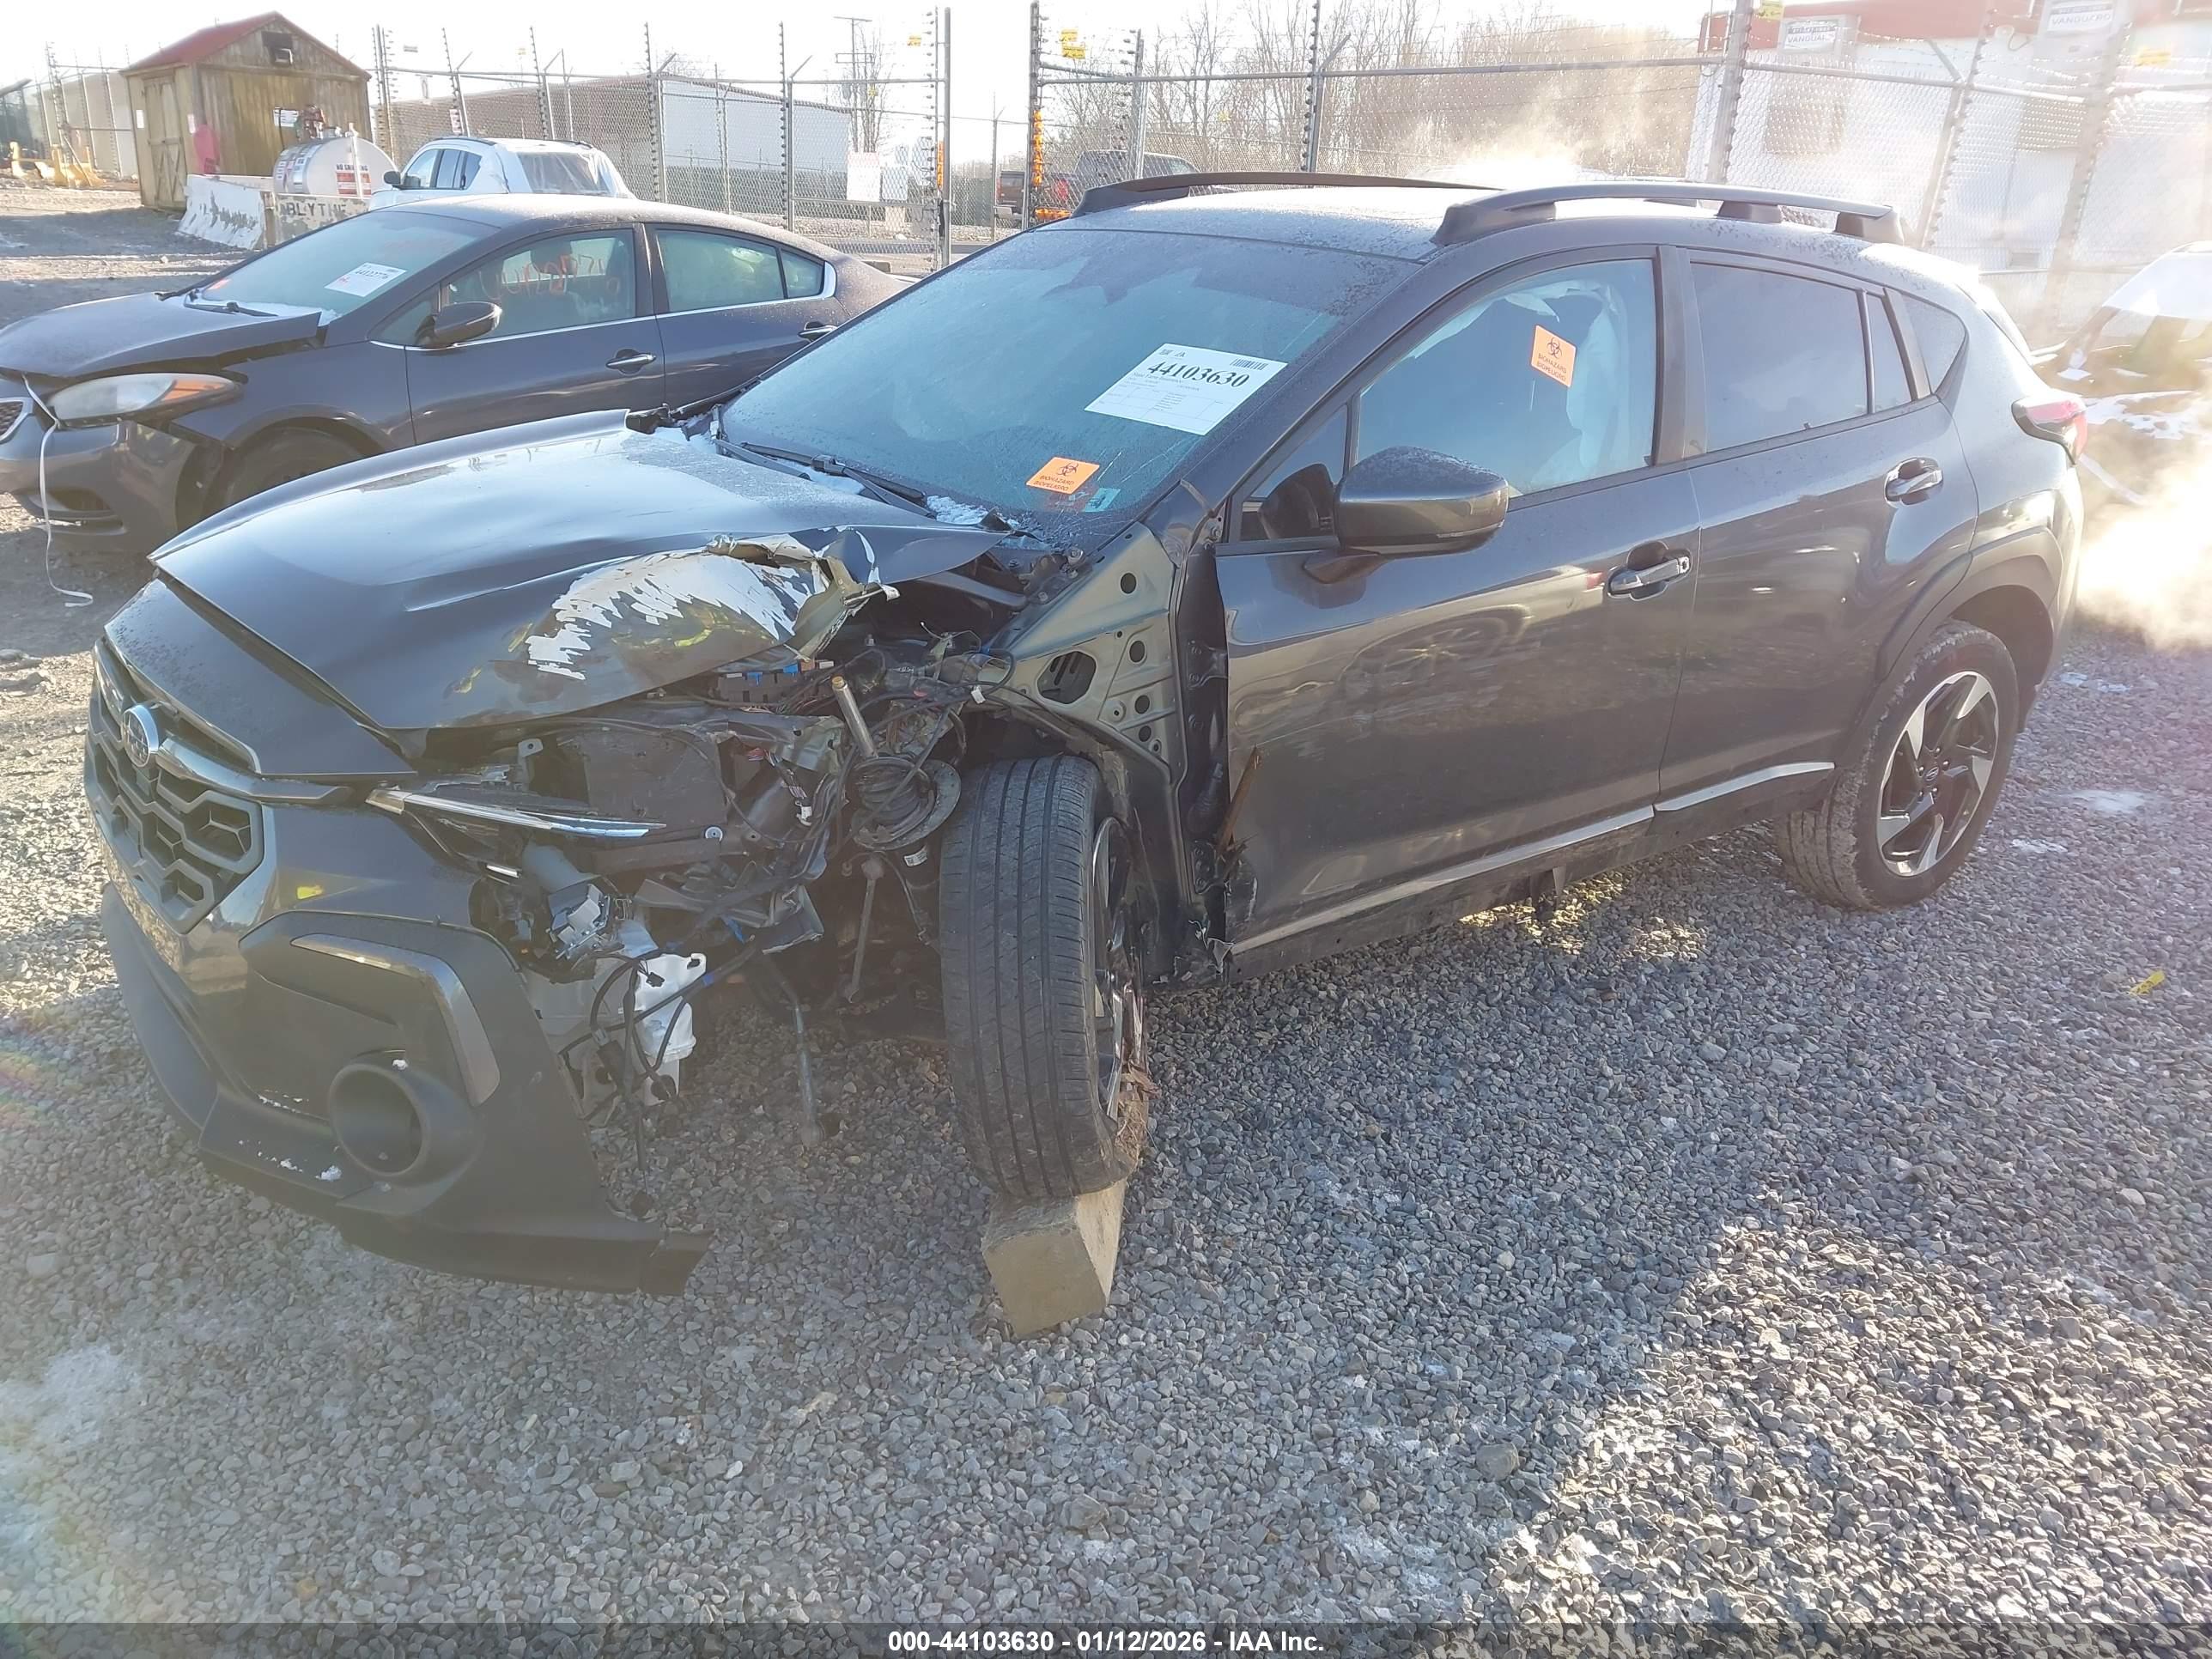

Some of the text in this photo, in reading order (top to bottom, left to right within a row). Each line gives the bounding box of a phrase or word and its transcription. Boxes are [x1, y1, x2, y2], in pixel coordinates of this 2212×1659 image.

[1538, 352, 1567, 374] BIOHAZARD
[1147, 362, 1250, 387] 44103630
[1039, 475, 1075, 486] BIOHAZARD
